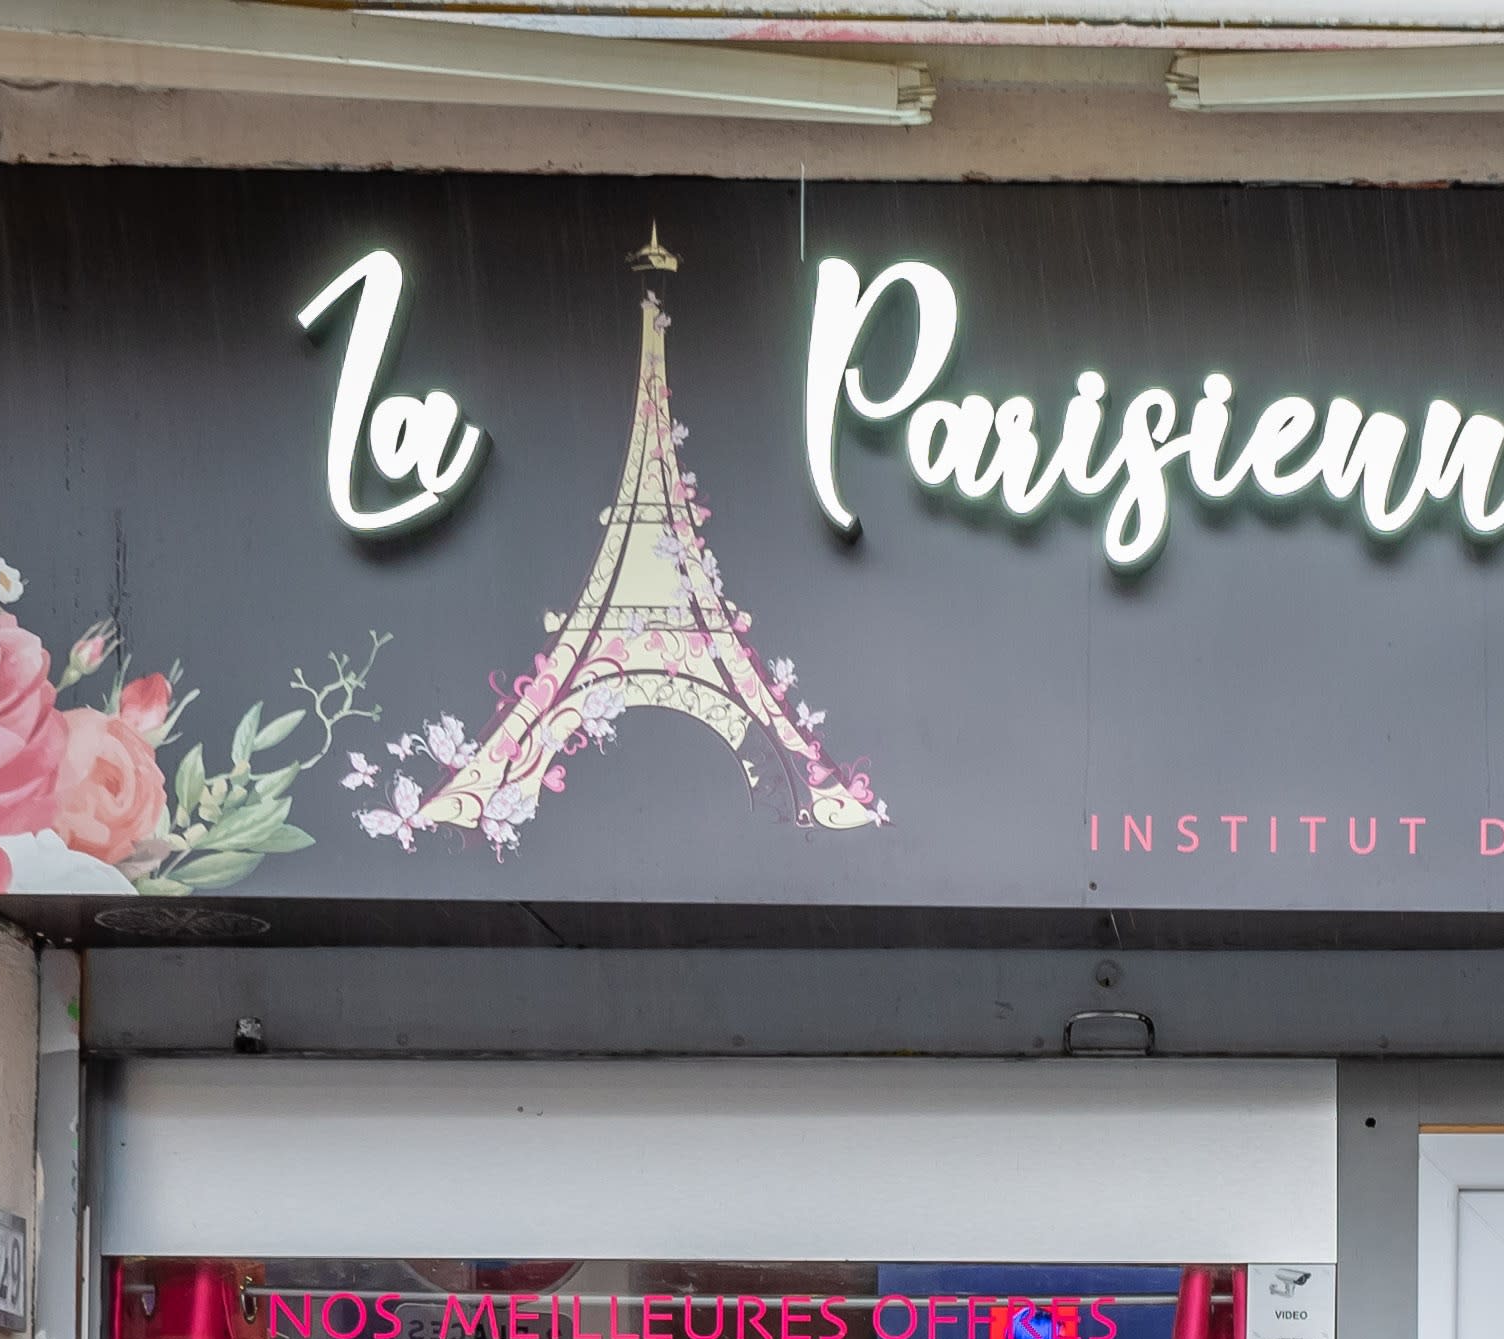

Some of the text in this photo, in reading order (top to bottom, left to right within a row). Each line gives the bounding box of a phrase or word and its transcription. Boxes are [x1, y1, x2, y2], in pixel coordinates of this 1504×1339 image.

[297, 250, 480, 529] La
[1091, 814, 1426, 855] INSTITUT
[1275, 1310, 1308, 1320] VIDEO
